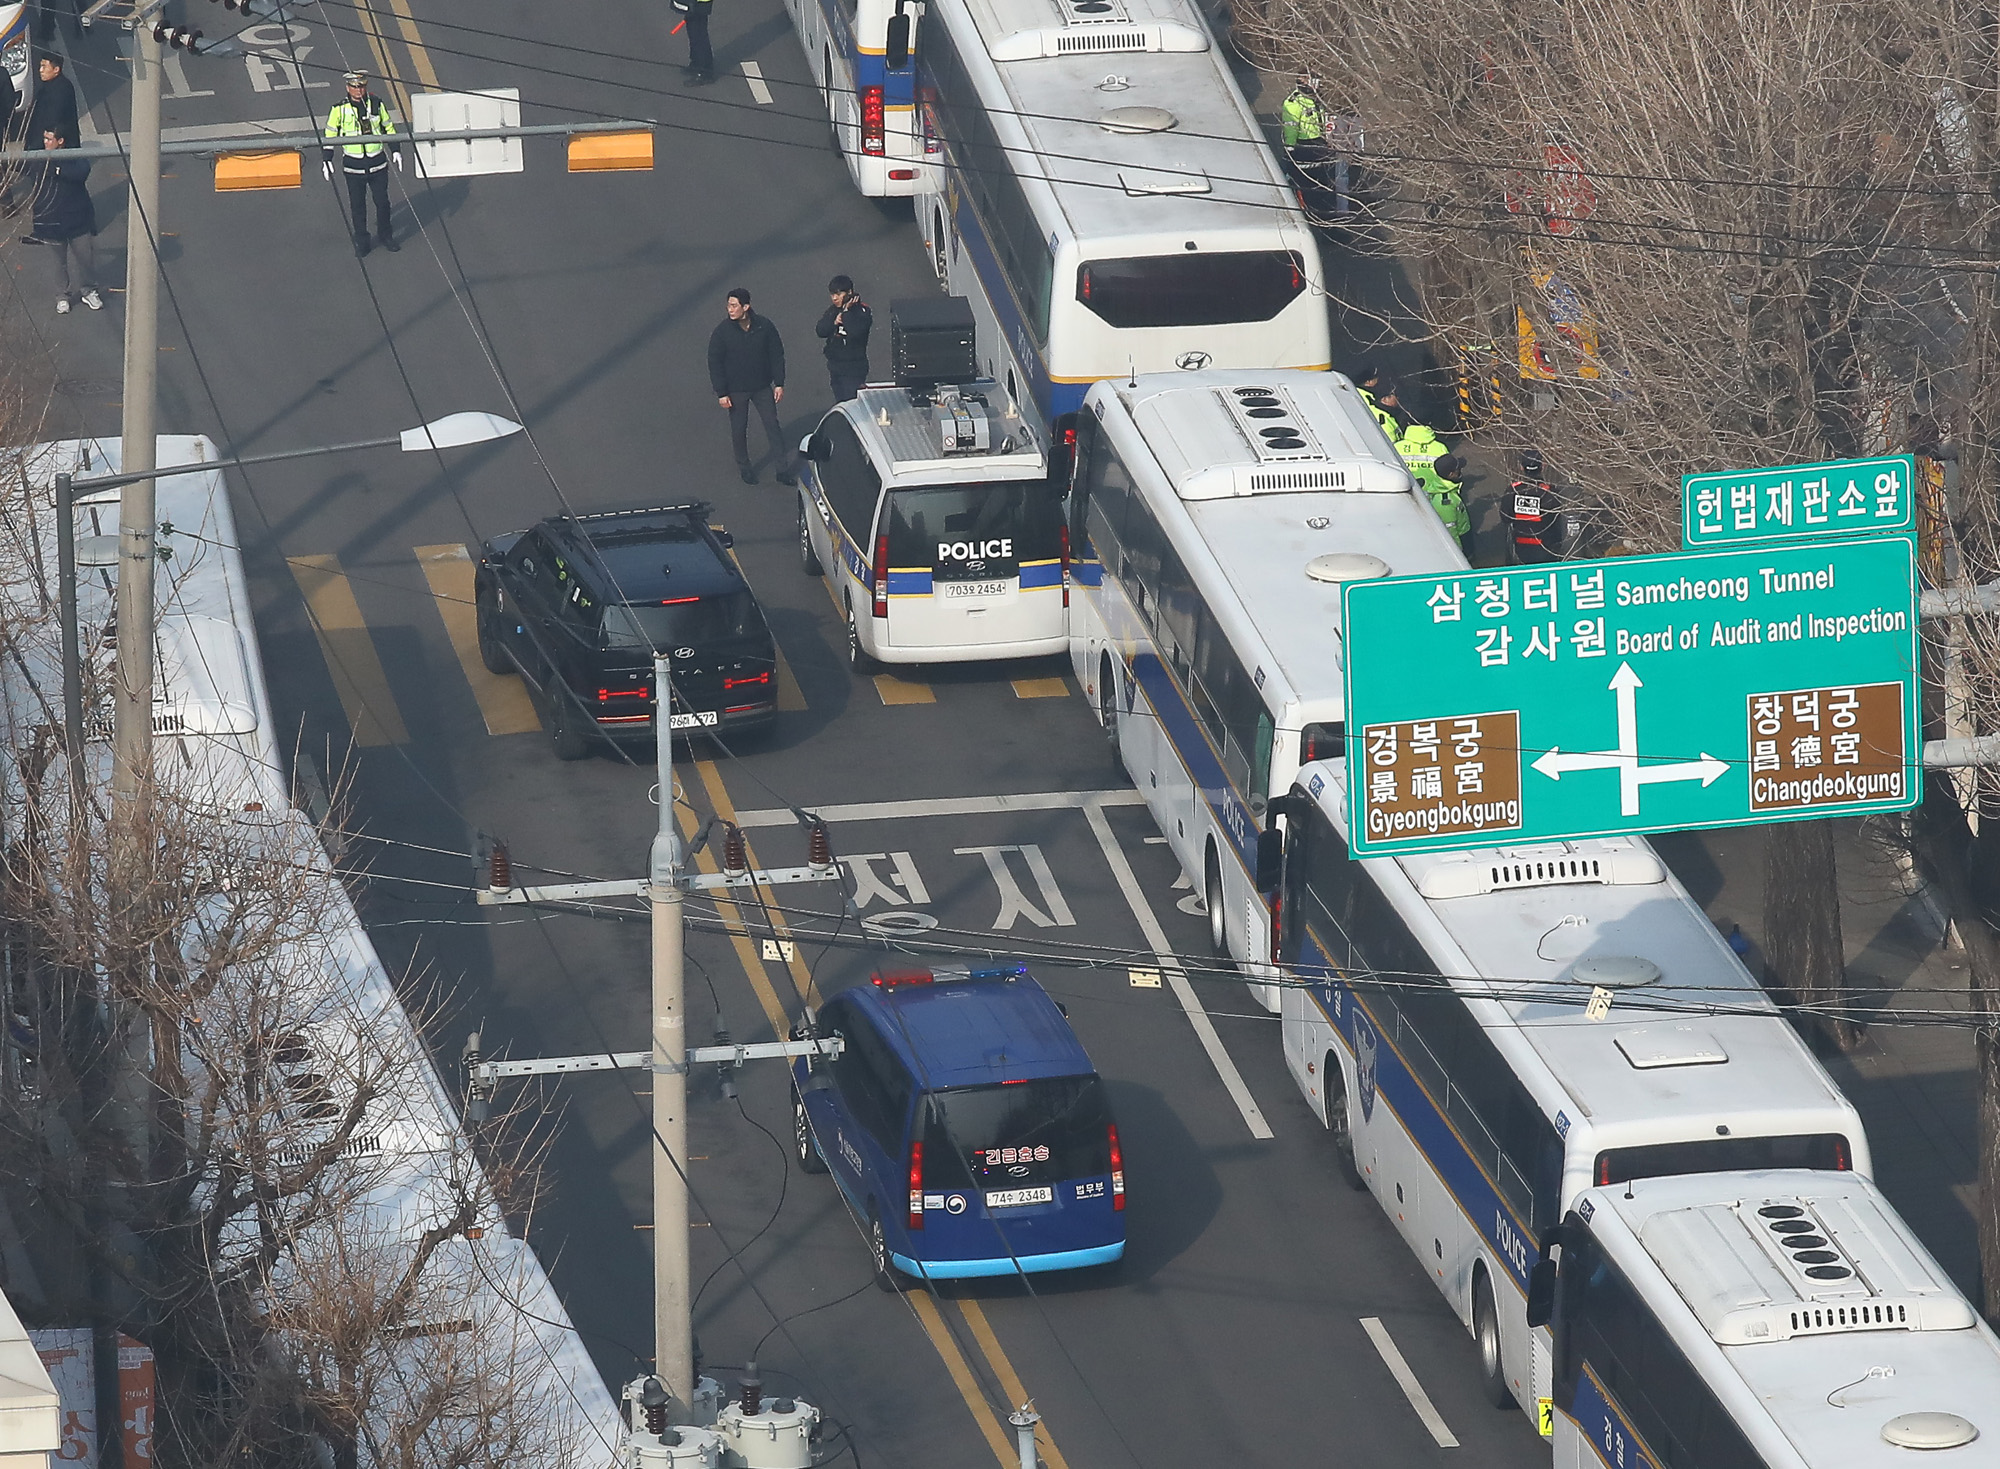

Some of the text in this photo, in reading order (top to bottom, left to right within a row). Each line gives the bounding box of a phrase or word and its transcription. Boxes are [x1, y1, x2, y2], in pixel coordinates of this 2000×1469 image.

[1696, 470, 1901, 534] 헌법재판소앞
[938, 538, 1013, 561] POLICE
[977, 583, 1003, 595] 2454
[1426, 569, 1606, 624] 삼청터널
[1616, 564, 1835, 607] Samcheong Tunnel
[1475, 617, 1607, 667] 감사원
[1616, 607, 1907, 656] Board of Audit and Inspection
[629, 668, 703, 680] SATA
[1753, 688, 1861, 735] 창덕궁
[1368, 718, 1484, 767] 경복궁
[1753, 732, 1861, 772] 昌德宮
[1369, 761, 1484, 804] 景福宮
[1754, 771, 1901, 804] Changdeokgung
[1222, 786, 1245, 849] POLICE
[1369, 799, 1518, 838] Gyeongbokgung
[985, 1144, 1049, 1165] 긴급호송
[992, 1189, 1047, 1204] 74수 2348
[1075, 1181, 1104, 1195] 법무부
[1496, 1209, 1527, 1279] POLICE
